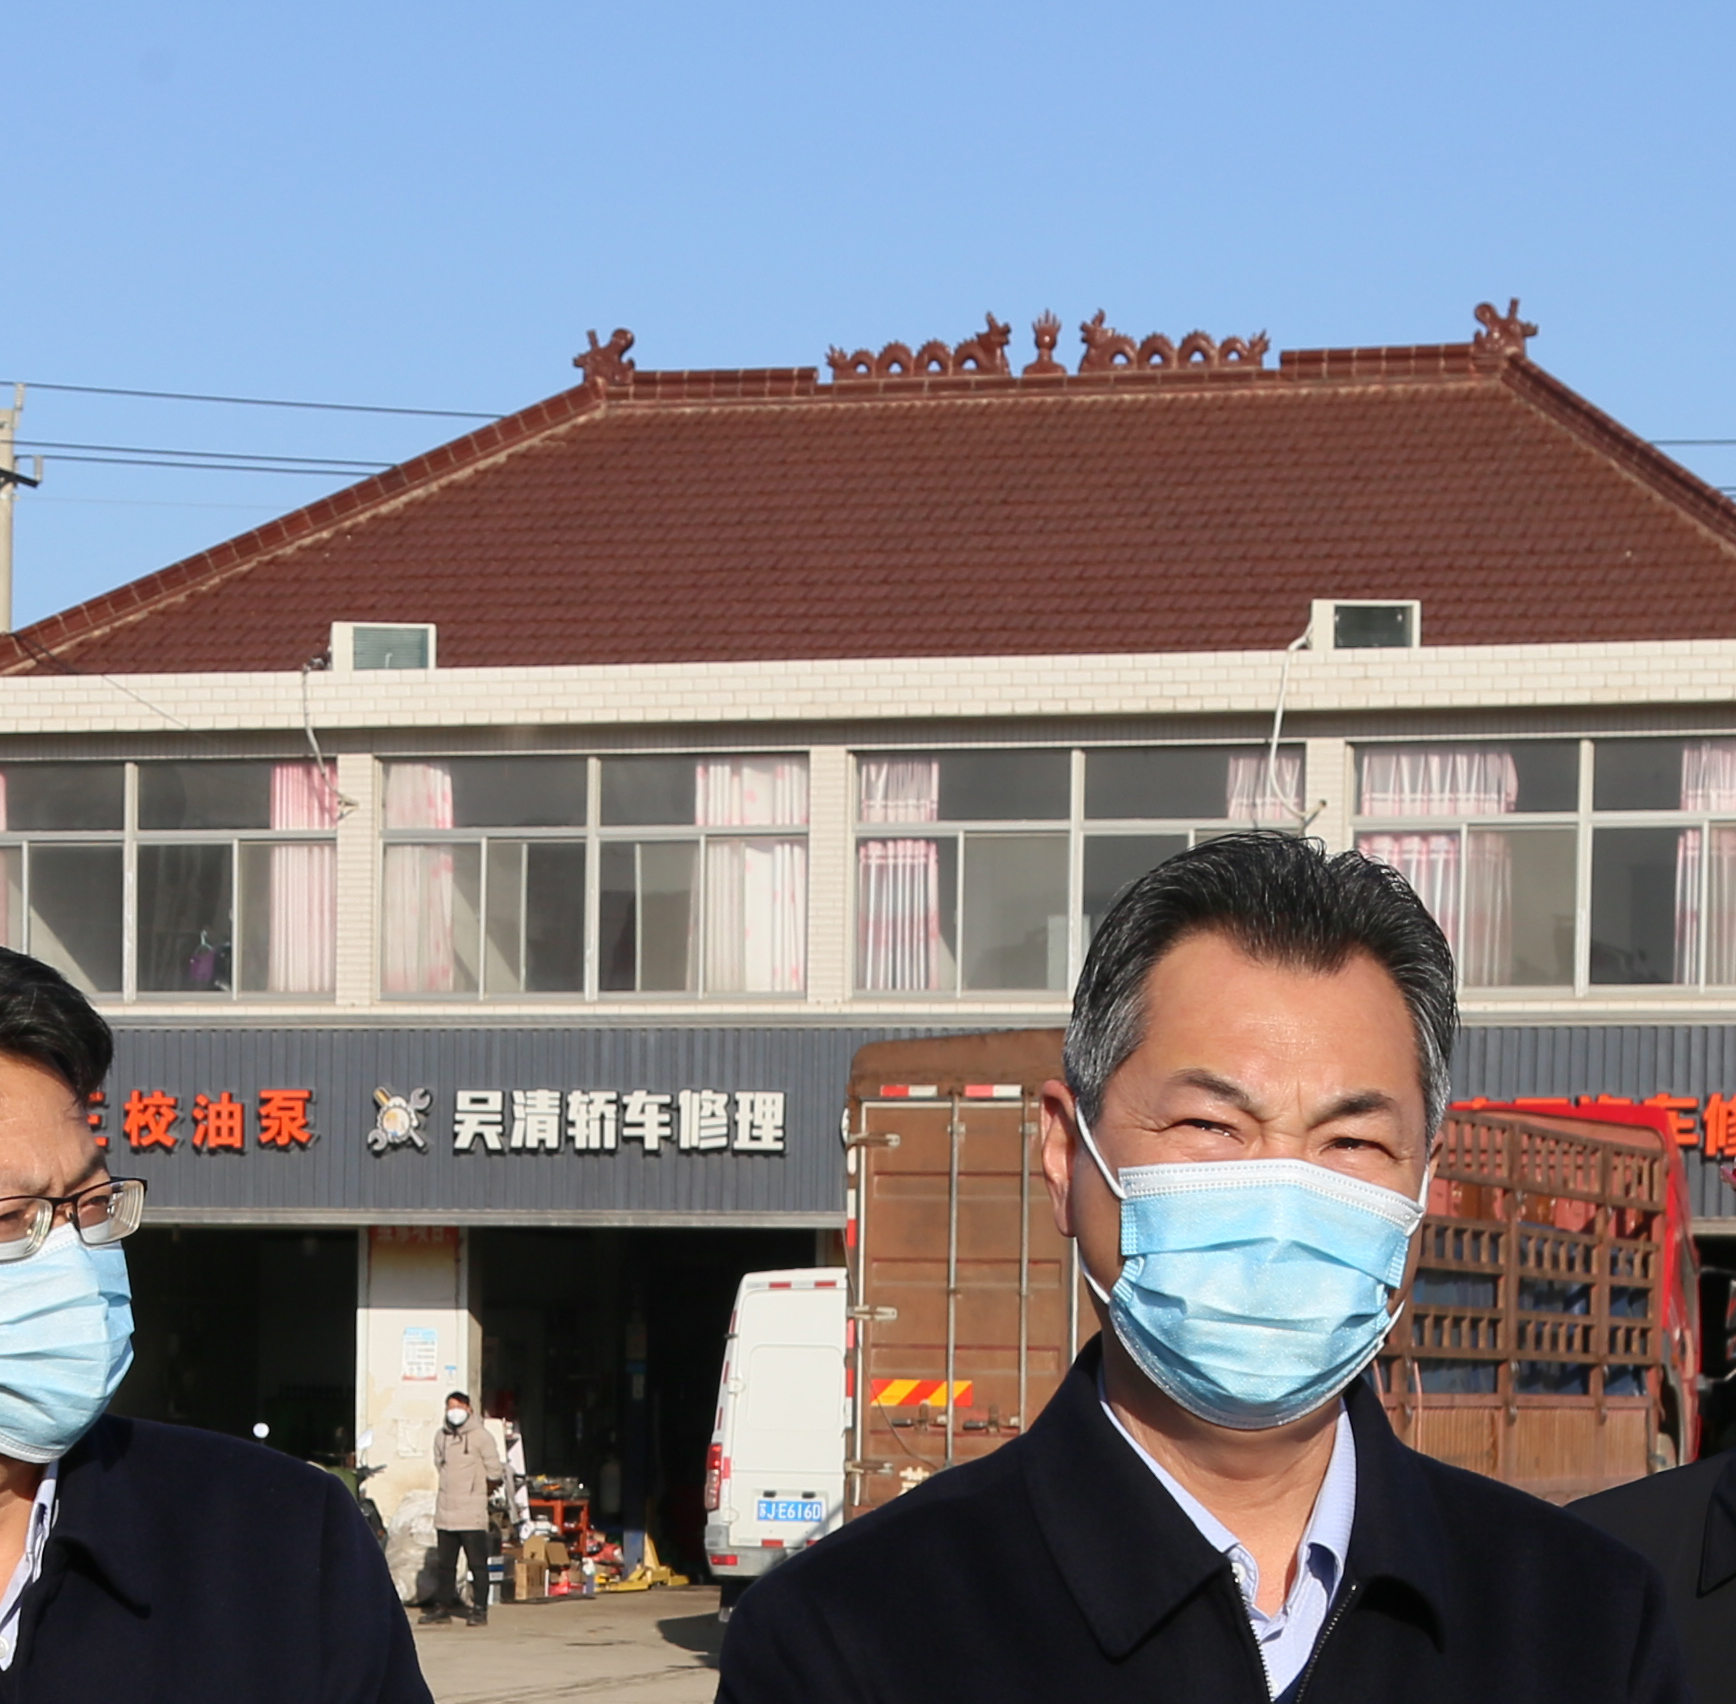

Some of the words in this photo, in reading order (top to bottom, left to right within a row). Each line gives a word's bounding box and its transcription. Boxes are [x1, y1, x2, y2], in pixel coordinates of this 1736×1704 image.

[87, 1089, 312, 1148] 校油泵
[453, 1089, 786, 1150] 吴清轿车修理
